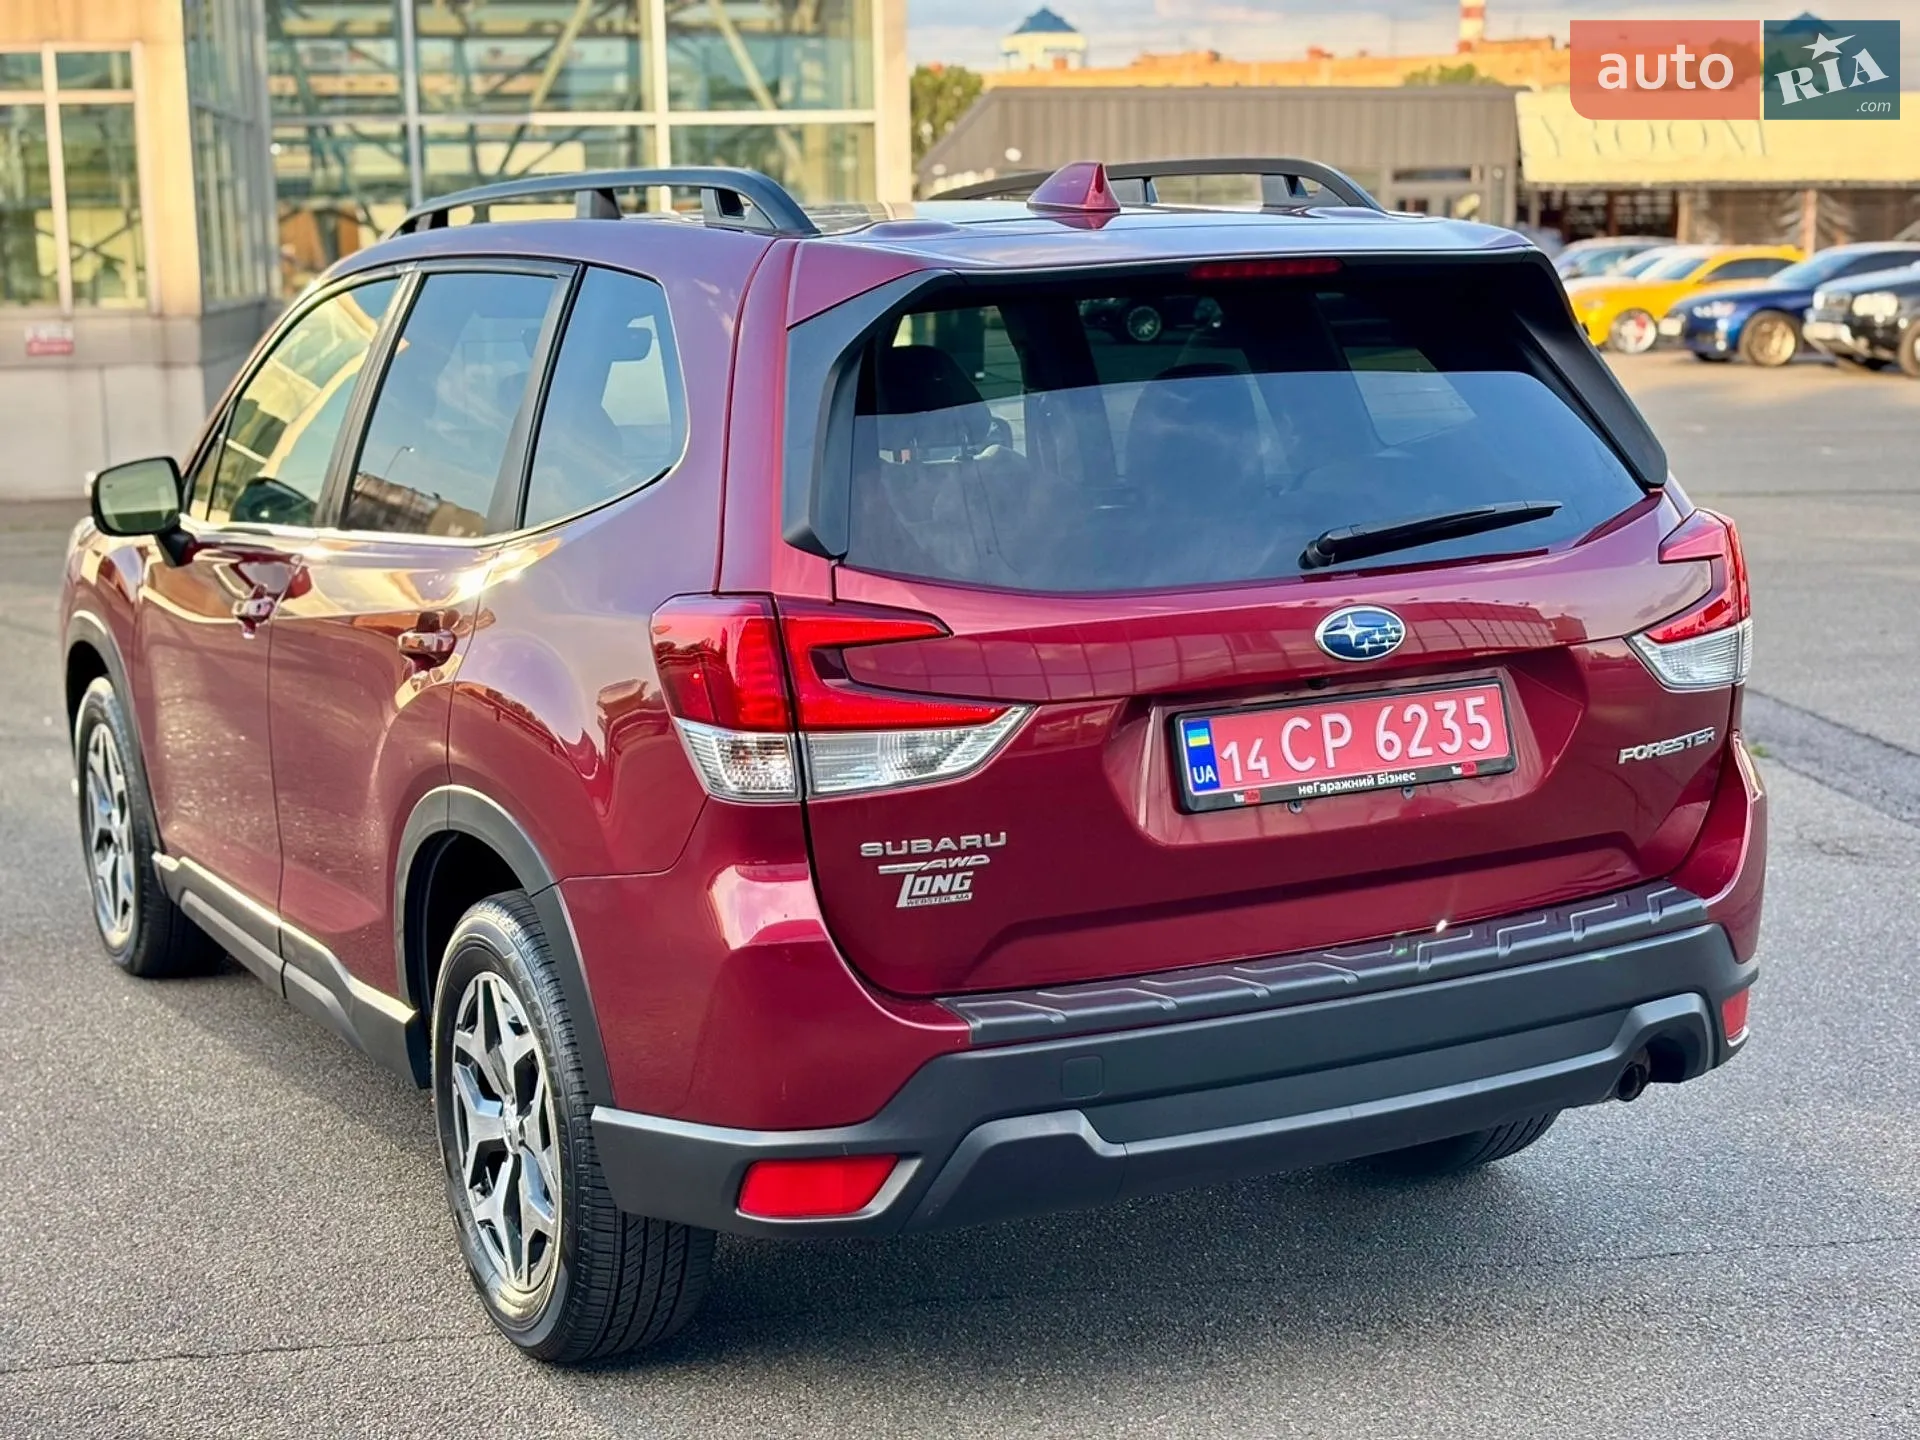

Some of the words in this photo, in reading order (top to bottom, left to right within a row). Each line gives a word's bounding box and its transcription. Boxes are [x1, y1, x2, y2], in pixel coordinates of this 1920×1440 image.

[1220, 738, 1270, 783] 14
[1375, 696, 1492, 761] 6235
[1617, 726, 1716, 764] FORESTER
[1192, 764, 1217, 784] UA
[1298, 774, 1375, 795] неГаражний
[1377, 771, 1416, 785] Бізнес
[860, 832, 1006, 857] SUBARU
[921, 854, 991, 871] AWD
[895, 871, 974, 908] LONG
